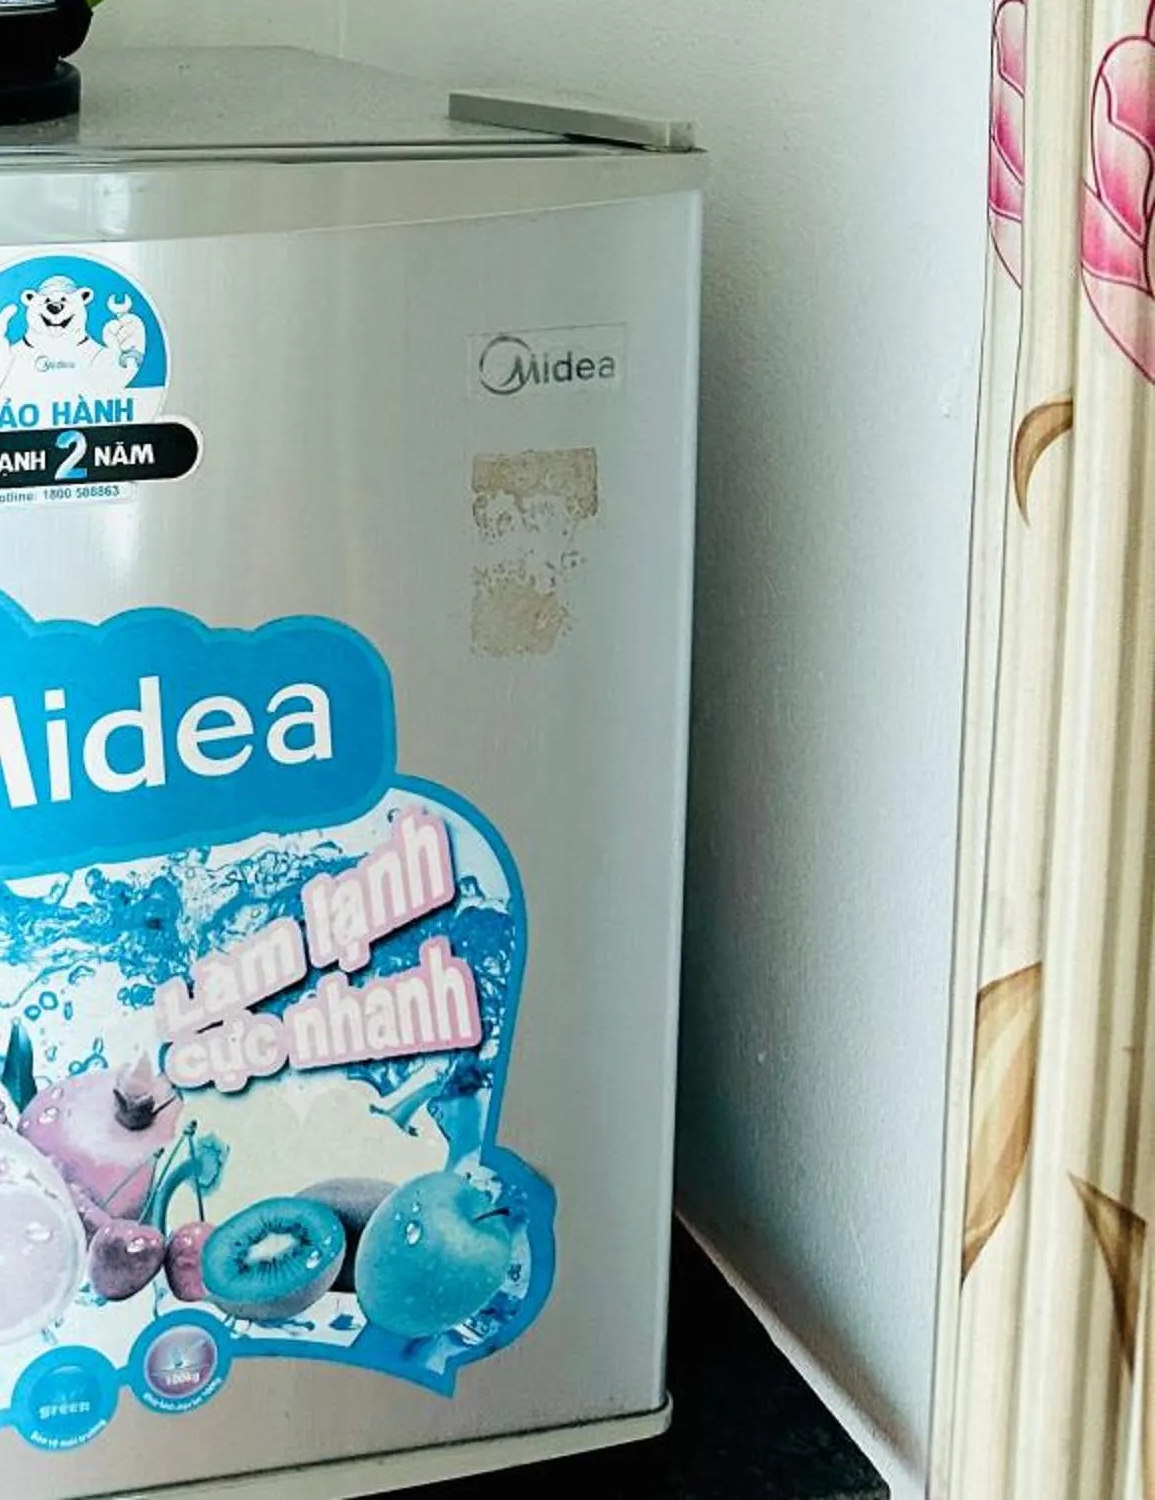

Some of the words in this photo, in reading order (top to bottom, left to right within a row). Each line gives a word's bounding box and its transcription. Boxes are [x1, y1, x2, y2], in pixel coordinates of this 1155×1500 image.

[479, 336, 615, 395] Midea
[52, 395, 135, 426] HÀNH
[54, 430, 88, 480] 2
[94, 441, 155, 467] NĂM
[308, 813, 447, 961] lạnh
[295, 945, 473, 1060] nhanh
